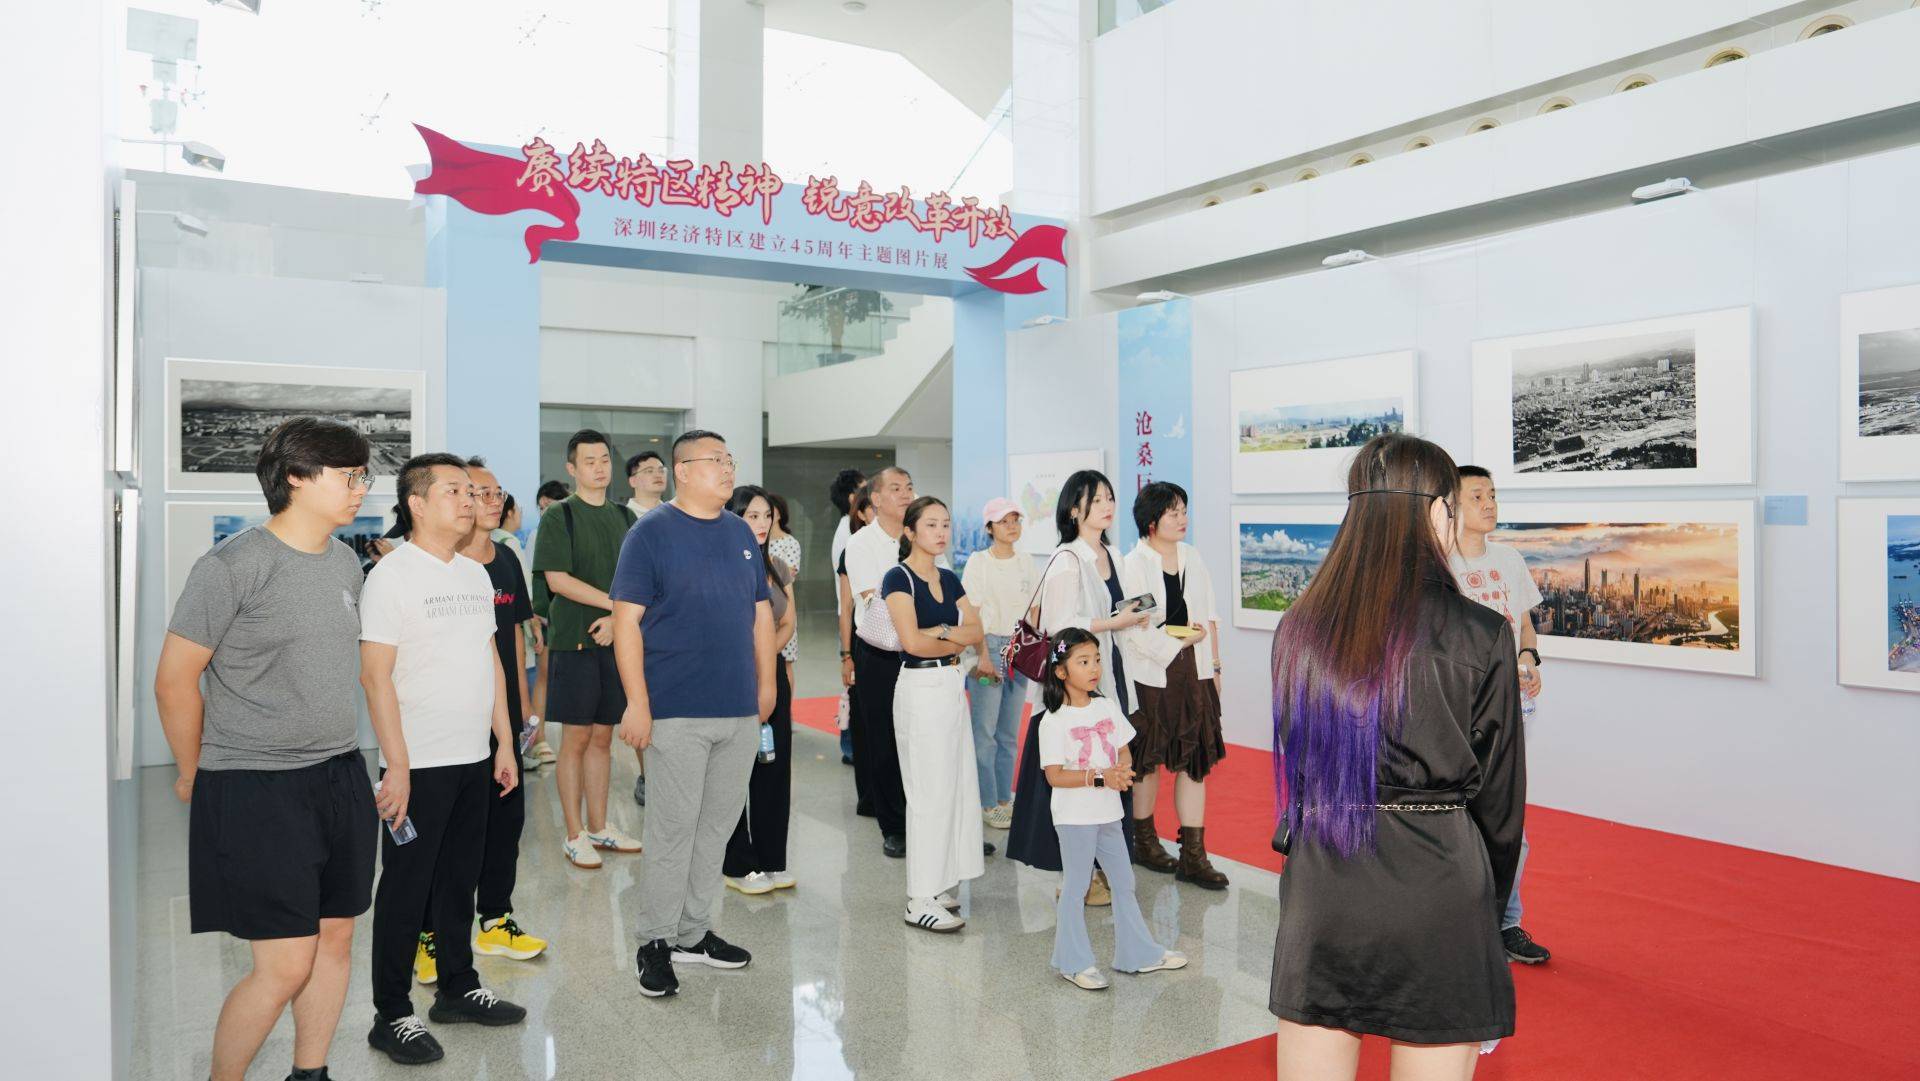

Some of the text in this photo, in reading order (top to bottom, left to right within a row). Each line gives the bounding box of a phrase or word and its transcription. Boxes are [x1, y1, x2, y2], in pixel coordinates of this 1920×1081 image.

[516, 137, 1018, 248] 赓续特区精神 锐意改革开放
[613, 216, 949, 270] 深圳经济特区建立45周年主题图片展
[424, 595, 454, 605] ARMANI
[426, 606, 457, 618] ARMANI
